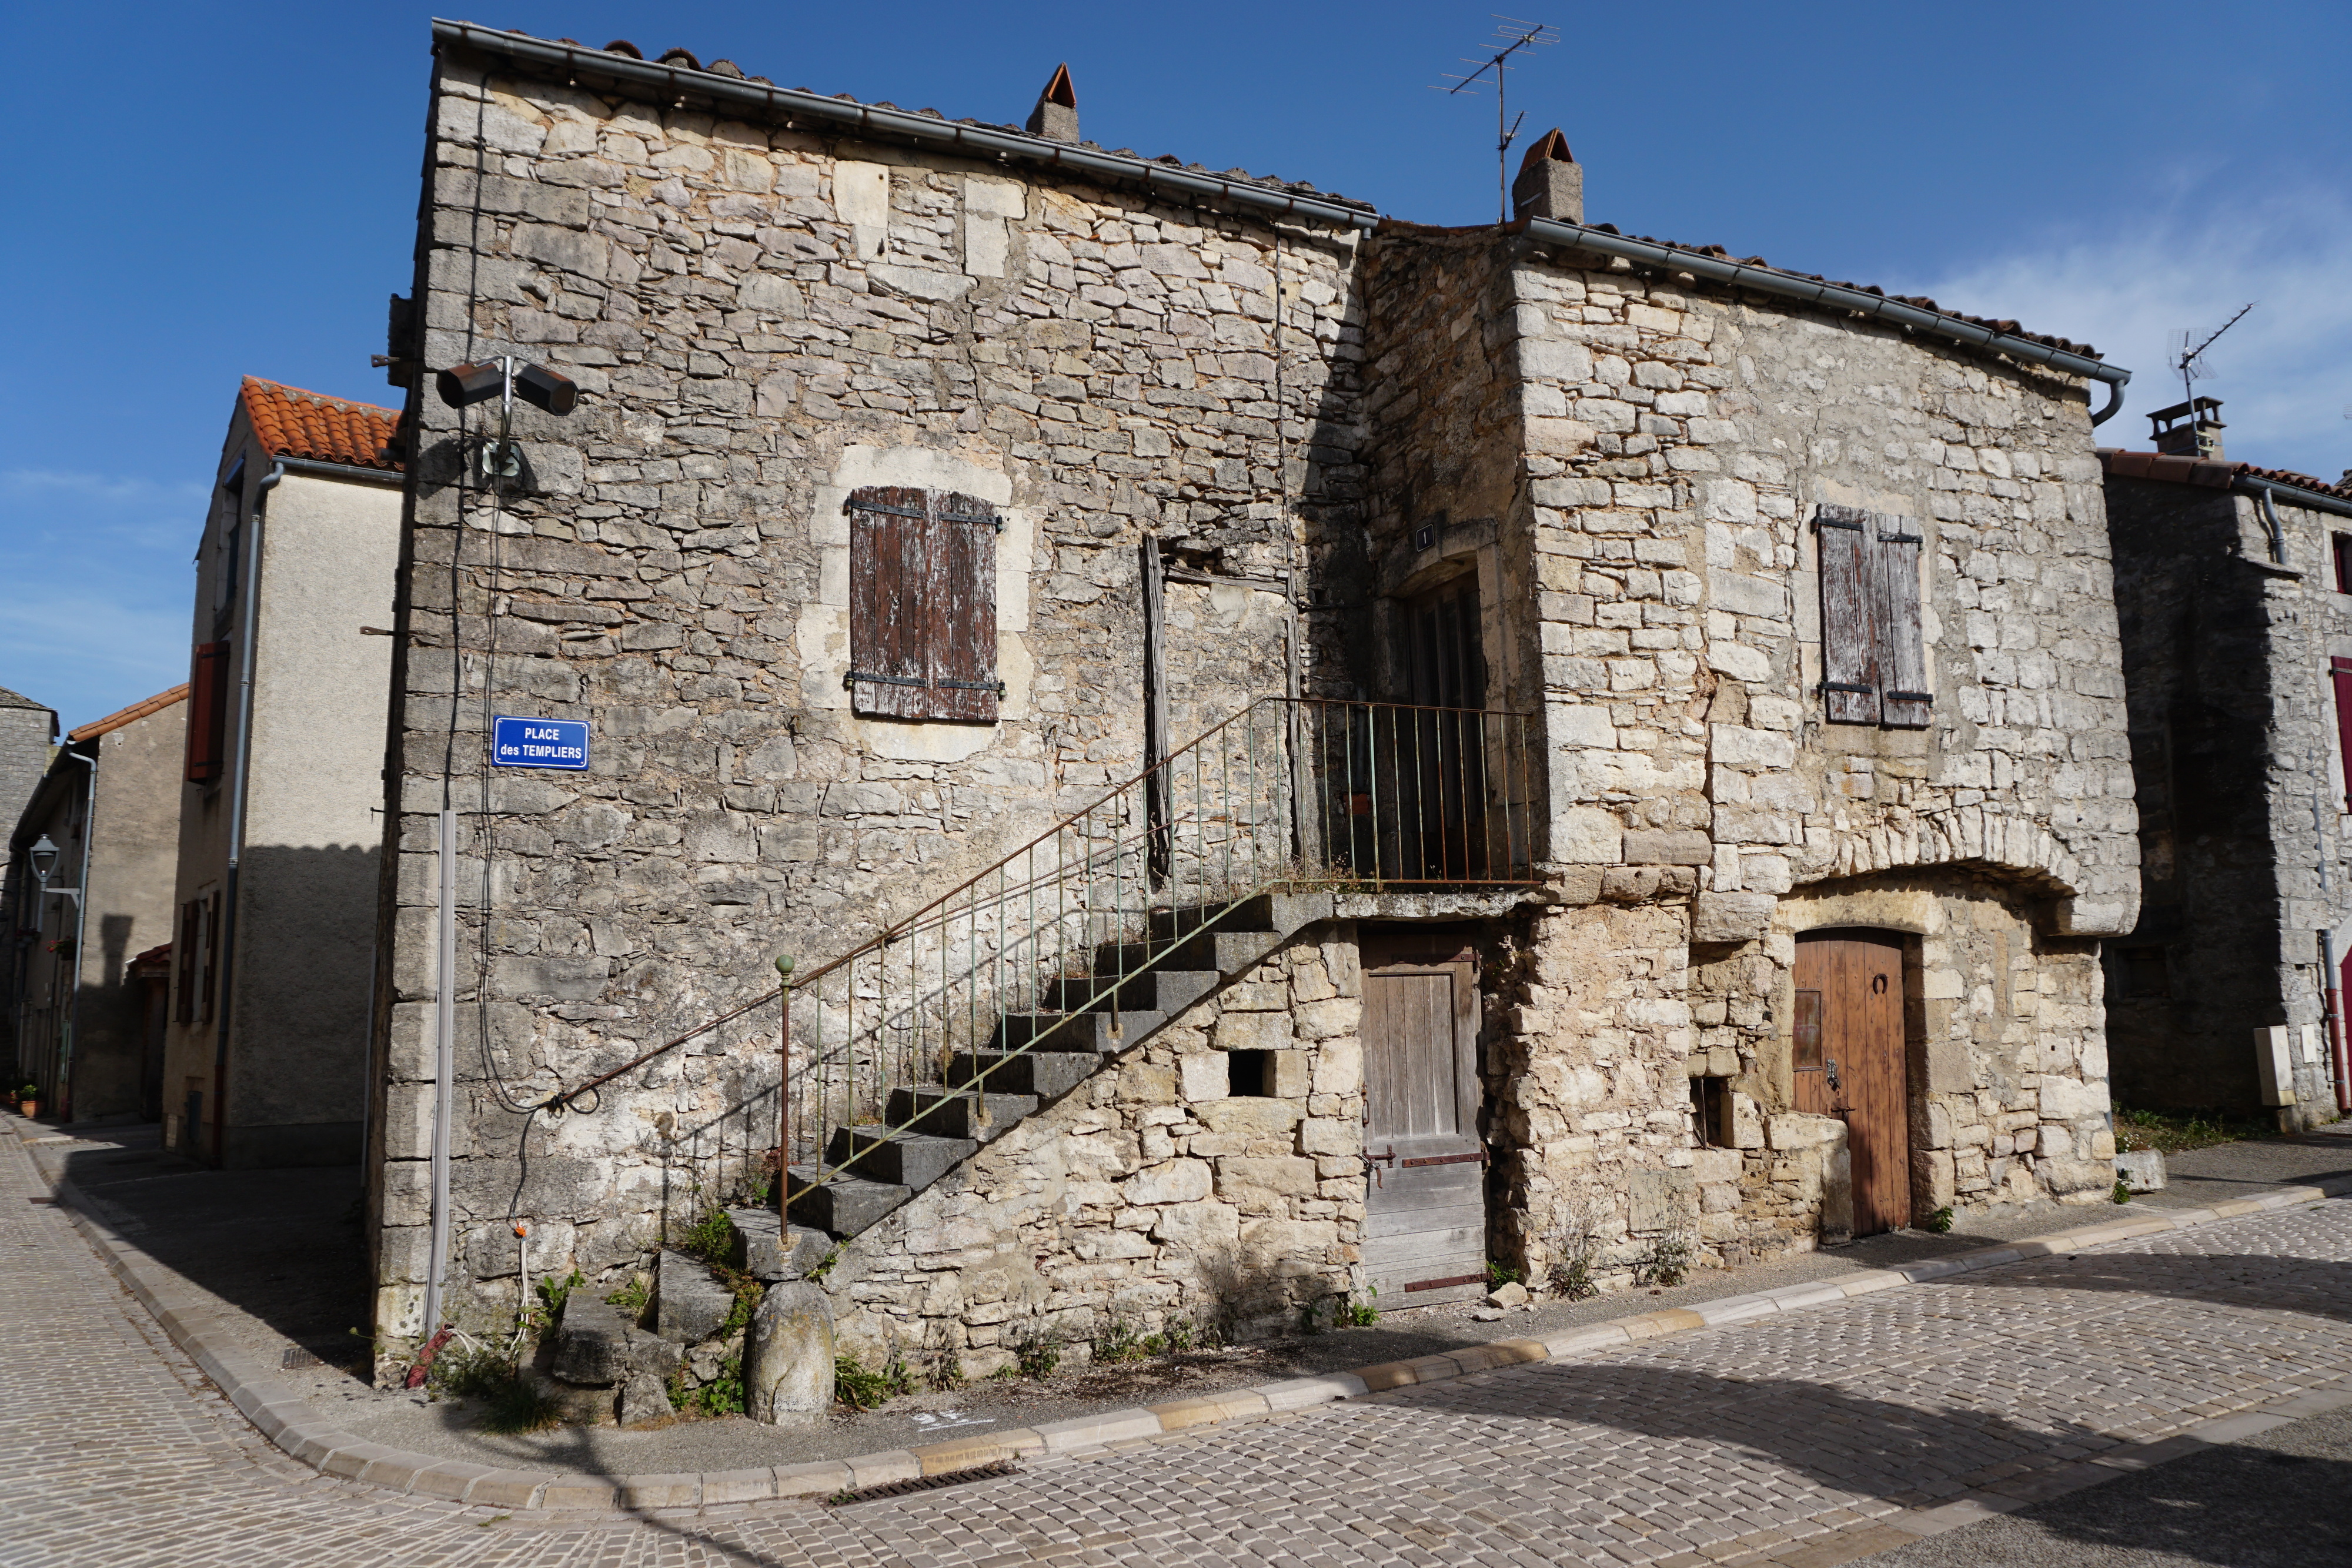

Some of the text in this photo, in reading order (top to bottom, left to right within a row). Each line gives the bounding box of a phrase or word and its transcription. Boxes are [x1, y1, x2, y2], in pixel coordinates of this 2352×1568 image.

[1424, 531, 1426, 544] 1
[525, 728, 560, 740] PLACE
[500, 744, 582, 758] des TEMPLIERS
